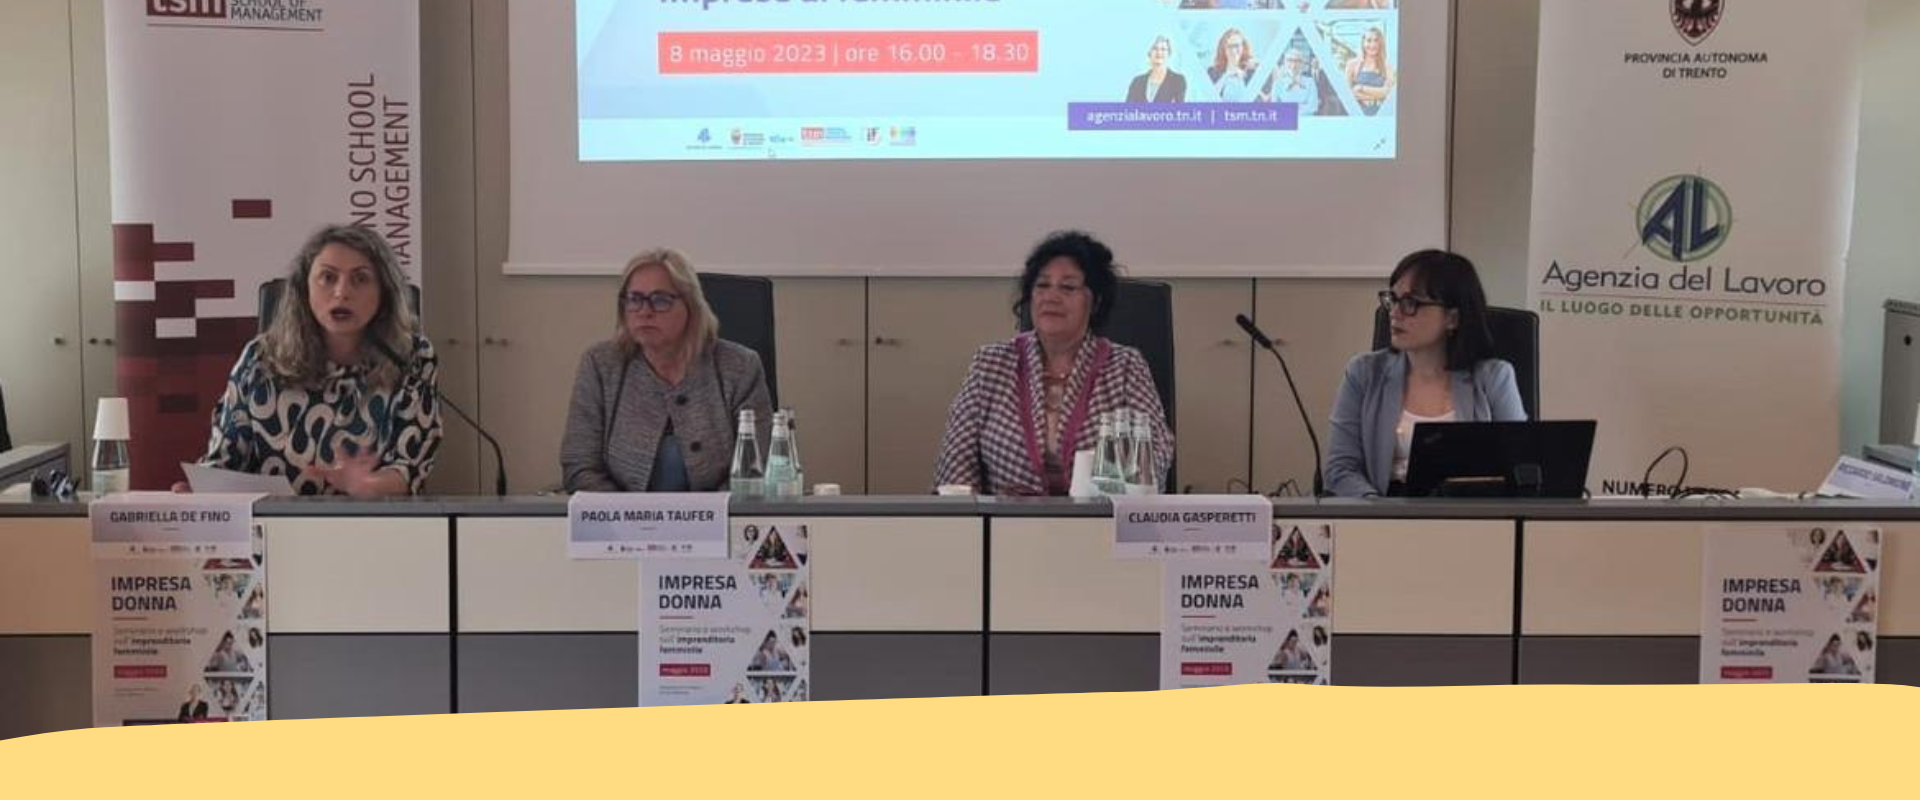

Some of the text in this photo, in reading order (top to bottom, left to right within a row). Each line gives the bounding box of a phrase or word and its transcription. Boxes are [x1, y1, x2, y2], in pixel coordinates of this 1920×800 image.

[231, 8, 322, 21] MANAGEMENT
[670, 45, 682, 62] 8
[690, 47, 765, 67] maggio
[773, 44, 826, 62] 2023
[845, 47, 878, 62] ore
[889, 44, 945, 62] 16.00
[971, 43, 1030, 61] 18.30
[1624, 53, 1768, 63] PROVINCIA AUTONOMA
[1662, 68, 1727, 78] DI TRENTO
[1087, 109, 1201, 124] agenzialavoro.tn.it
[1224, 110, 1278, 122] tsm.tn.it
[348, 73, 376, 182] SCHOOL
[1542, 260, 1826, 297] Agenzia del Lavoro
[1540, 300, 1554, 312] IL
[1561, 300, 1624, 315] LUOGO
[1629, 304, 1683, 318] DELLE
[110, 511, 231, 523] GABRIELLA DE FINO
[581, 510, 715, 522] PAOLA MARIA TAUFER
[1128, 512, 1257, 523] CLAUDIA GASPERETTI
[111, 576, 192, 591] IMPRESA
[659, 575, 737, 590] IMPRESA
[1181, 575, 1260, 589] IMPRESA
[1722, 578, 1801, 593] IMPRESA
[112, 596, 177, 611] DONNA
[659, 595, 722, 609] DONNA
[1181, 594, 1244, 609] DONNA
[1722, 597, 1786, 612] DONNA
